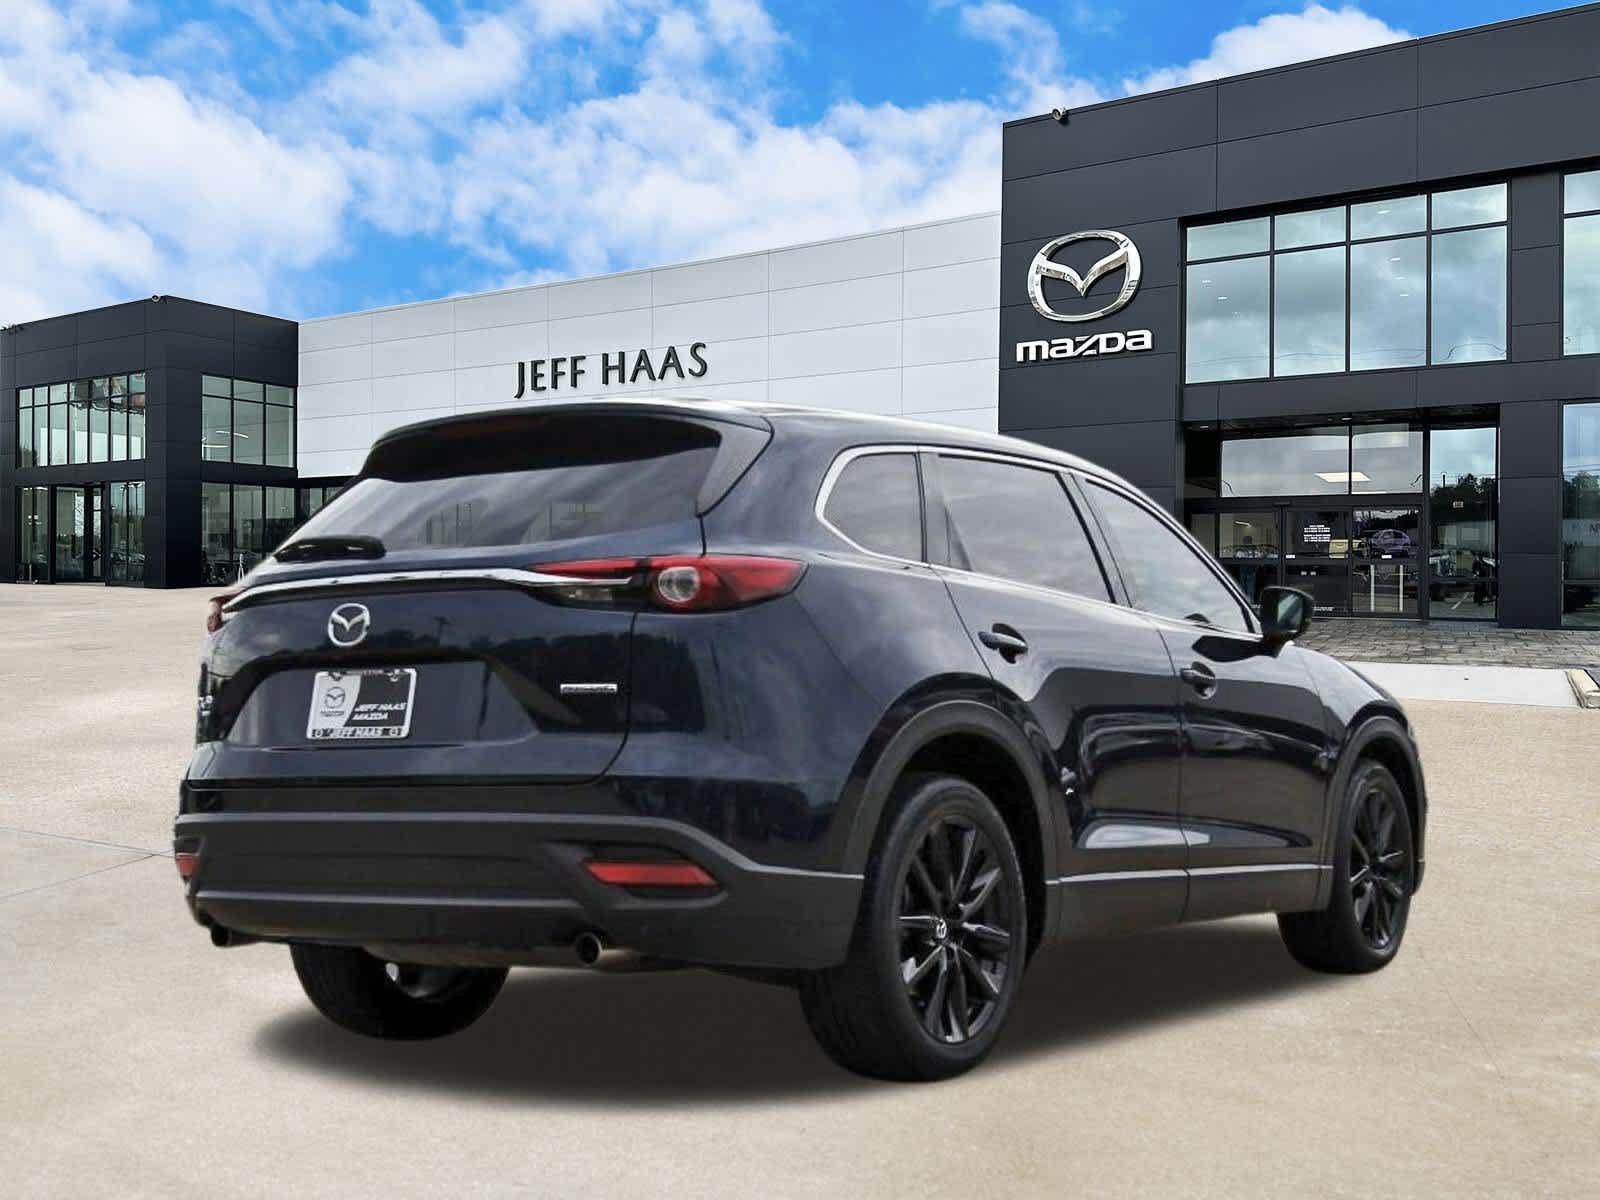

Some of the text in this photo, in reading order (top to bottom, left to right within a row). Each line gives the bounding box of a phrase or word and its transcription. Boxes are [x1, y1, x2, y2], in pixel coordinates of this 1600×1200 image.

[514, 342, 708, 399] JEFF HAAS
[354, 702, 408, 712] JEFF HAAS
[329, 727, 382, 738] JEFF HAAS
